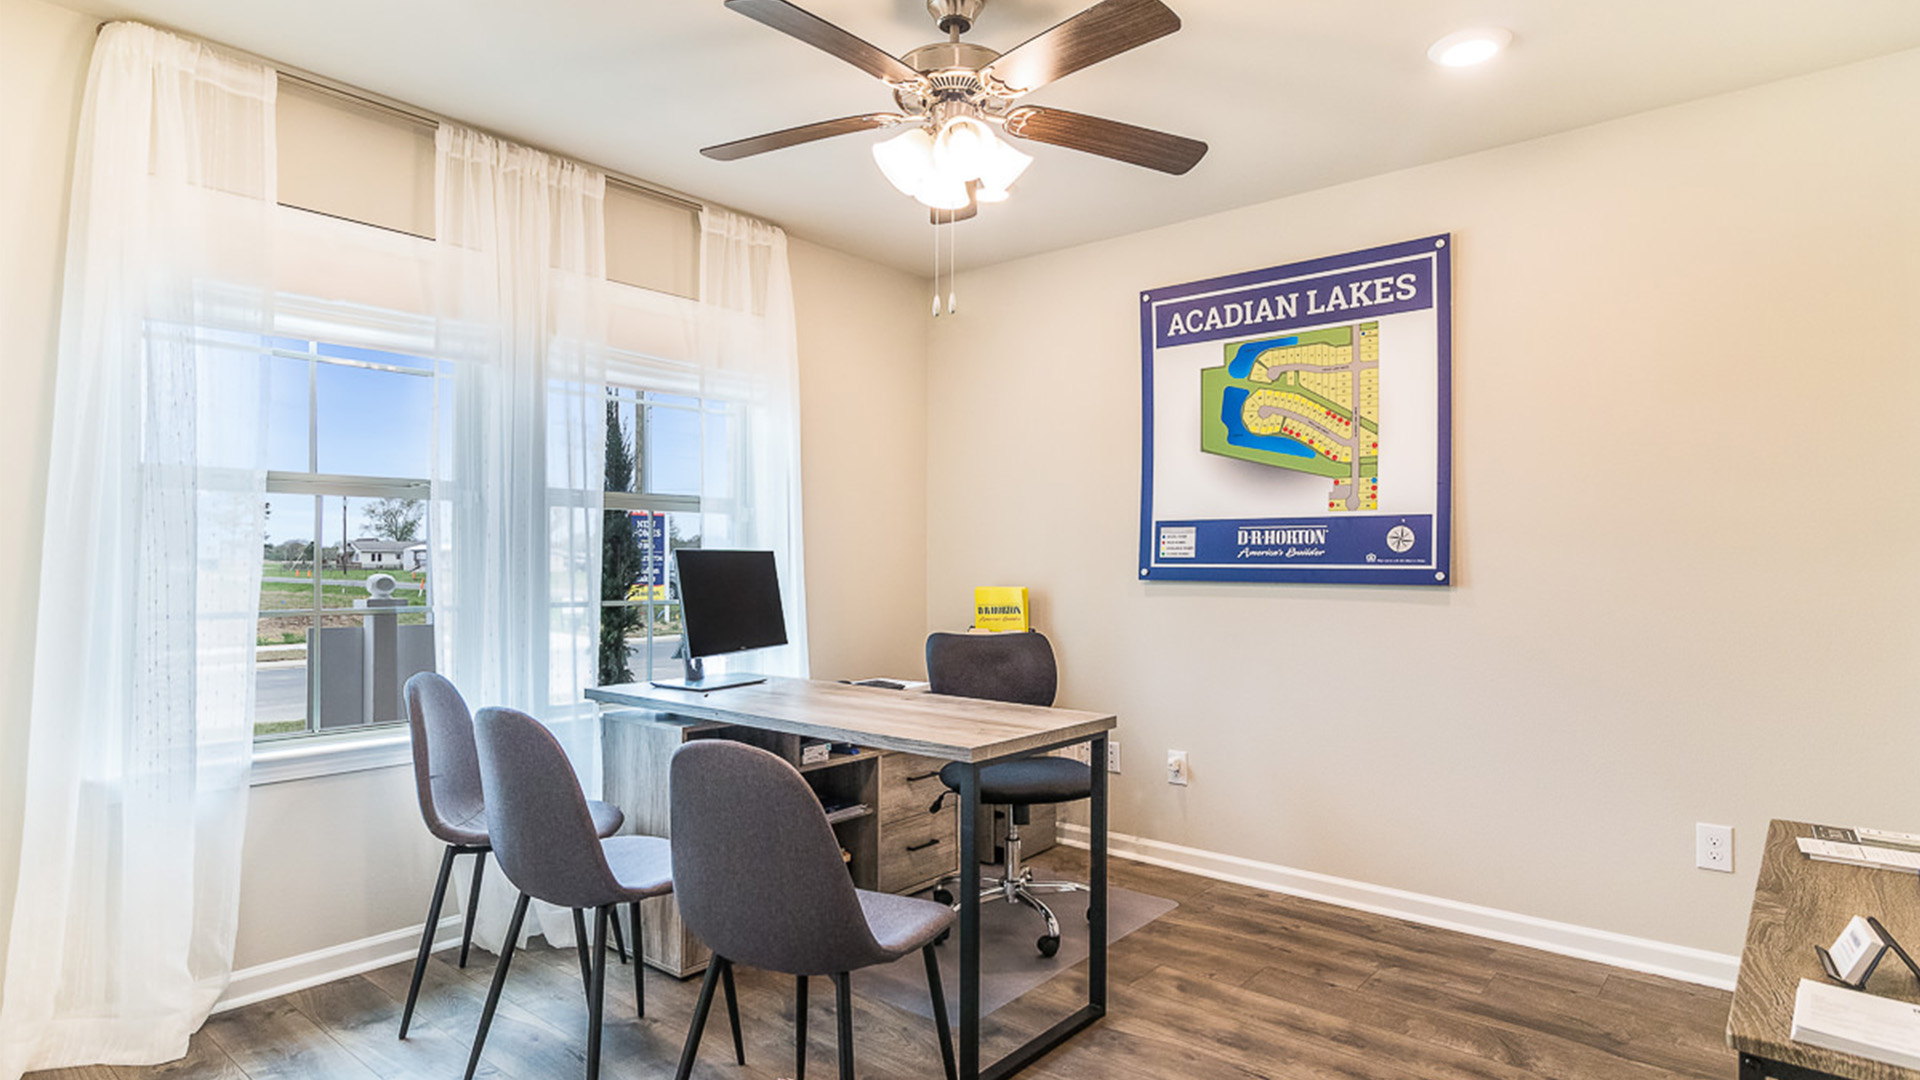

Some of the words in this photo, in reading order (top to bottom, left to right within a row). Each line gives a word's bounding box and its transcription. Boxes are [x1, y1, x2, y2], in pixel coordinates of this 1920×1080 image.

[1167, 293, 1299, 337] ACADIAN
[1306, 273, 1417, 315] LAKES
[1237, 547, 1284, 558] America's
[1285, 547, 1326, 558] Builder
